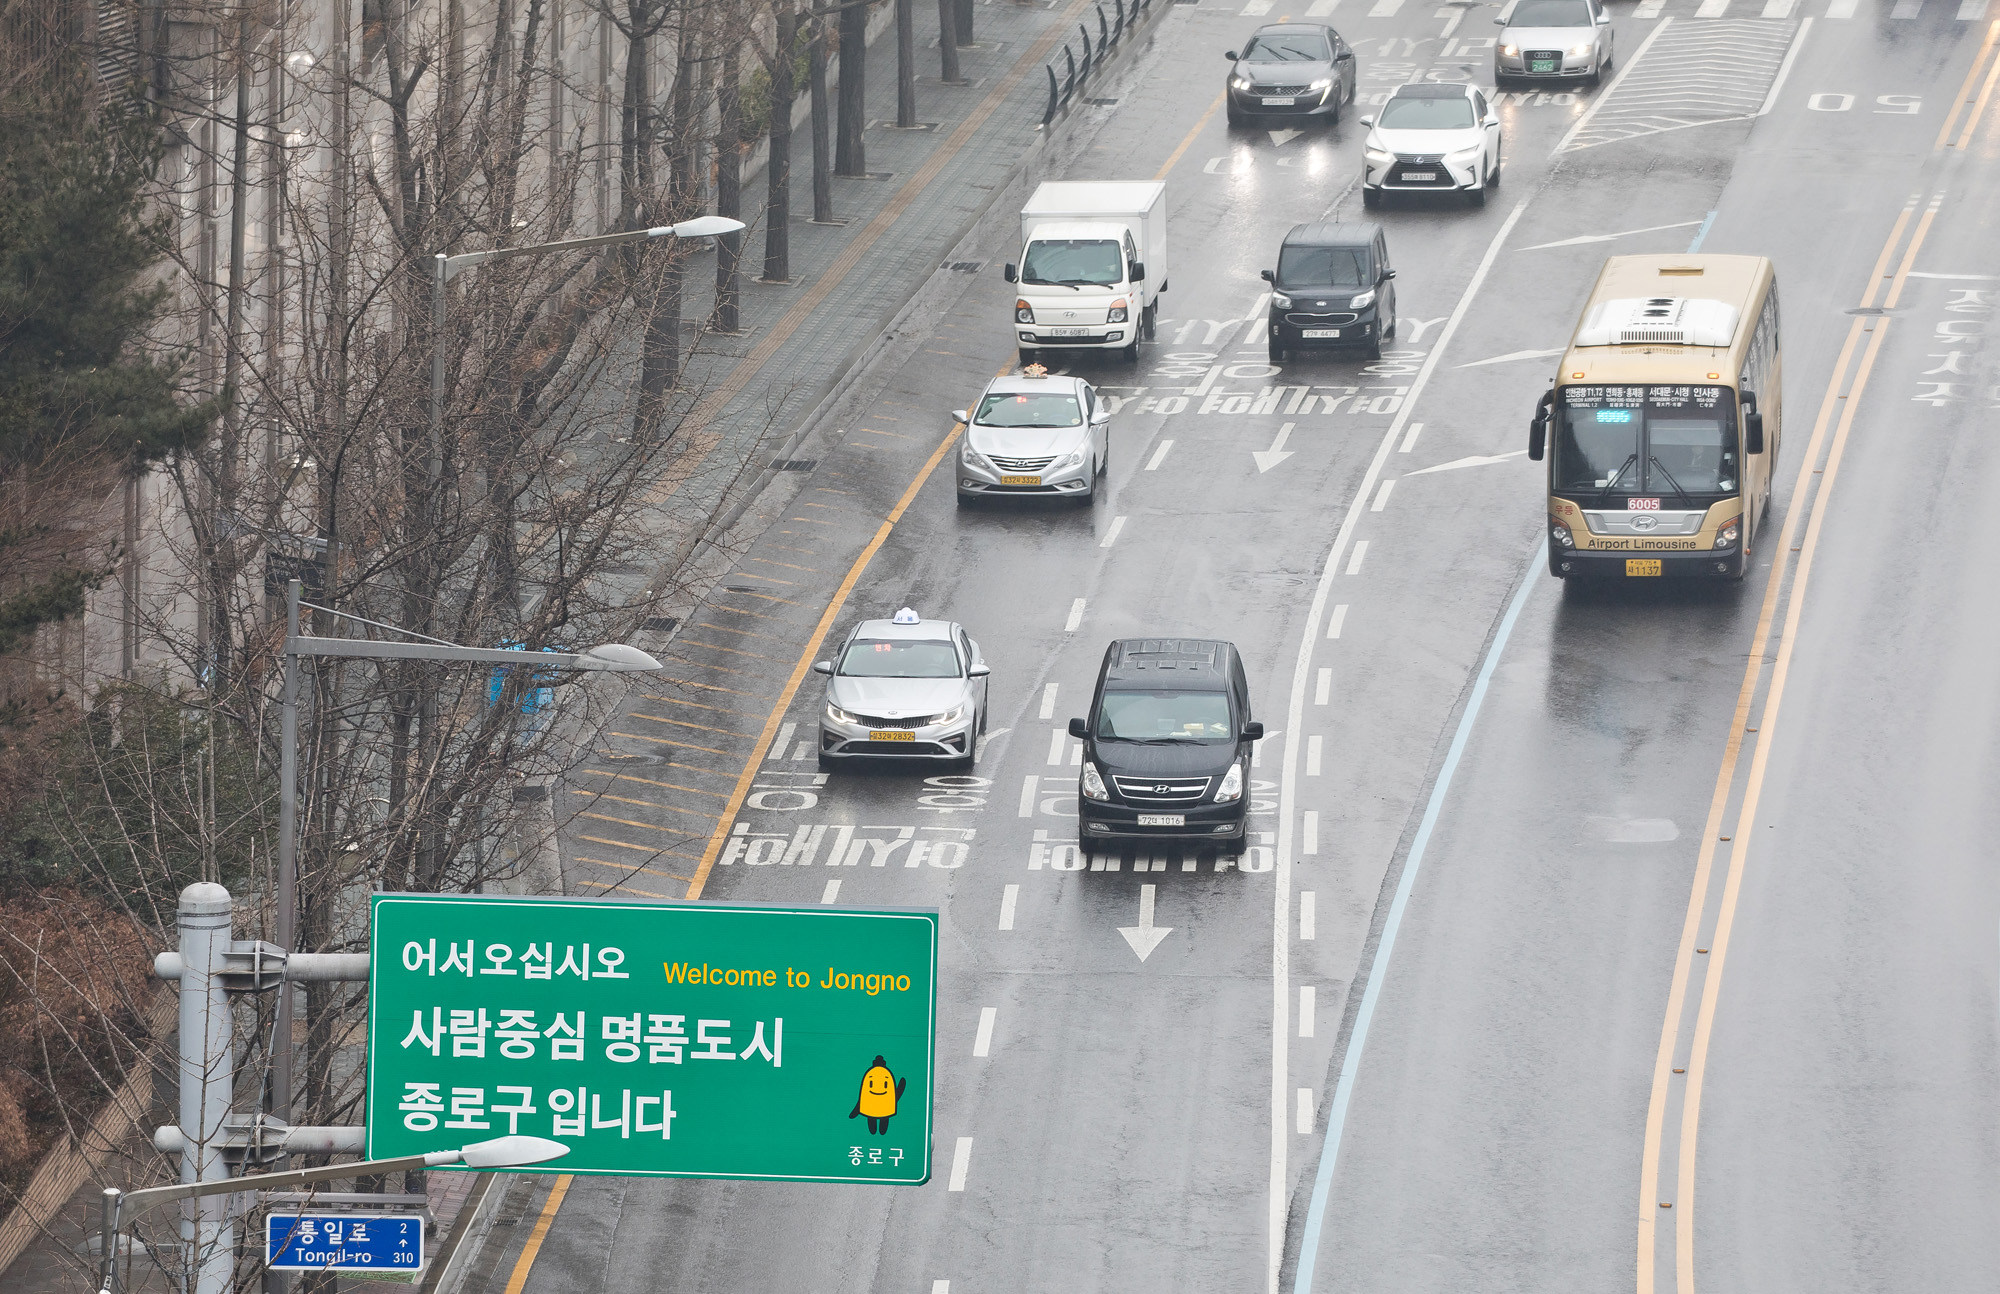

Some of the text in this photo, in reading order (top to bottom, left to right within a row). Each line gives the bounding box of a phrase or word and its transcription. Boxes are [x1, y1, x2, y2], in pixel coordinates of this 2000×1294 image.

[1807, 93, 1922, 114] 50
[1587, 387, 1603, 398] T1,T2
[1693, 387, 1719, 398] 인사동
[1555, 505, 1573, 516] 우등
[1629, 499, 1659, 510] 6005
[1588, 539, 1696, 551] Airport Limousine
[893, 732, 912, 740] 2832
[1161, 816, 1180, 825] 1016
[402, 938, 630, 981] 어서오십시오
[663, 962, 911, 996] Welcome to Jongno
[400, 1006, 783, 1068] 사람중심 명품도시
[398, 1082, 677, 1140] 종로구 입니다
[848, 1146, 905, 1167] 종로구
[297, 1220, 371, 1246] 통일로
[400, 1223, 408, 1234] 2
[295, 1247, 372, 1265] Tongil-ro
[393, 1252, 414, 1264] 310
